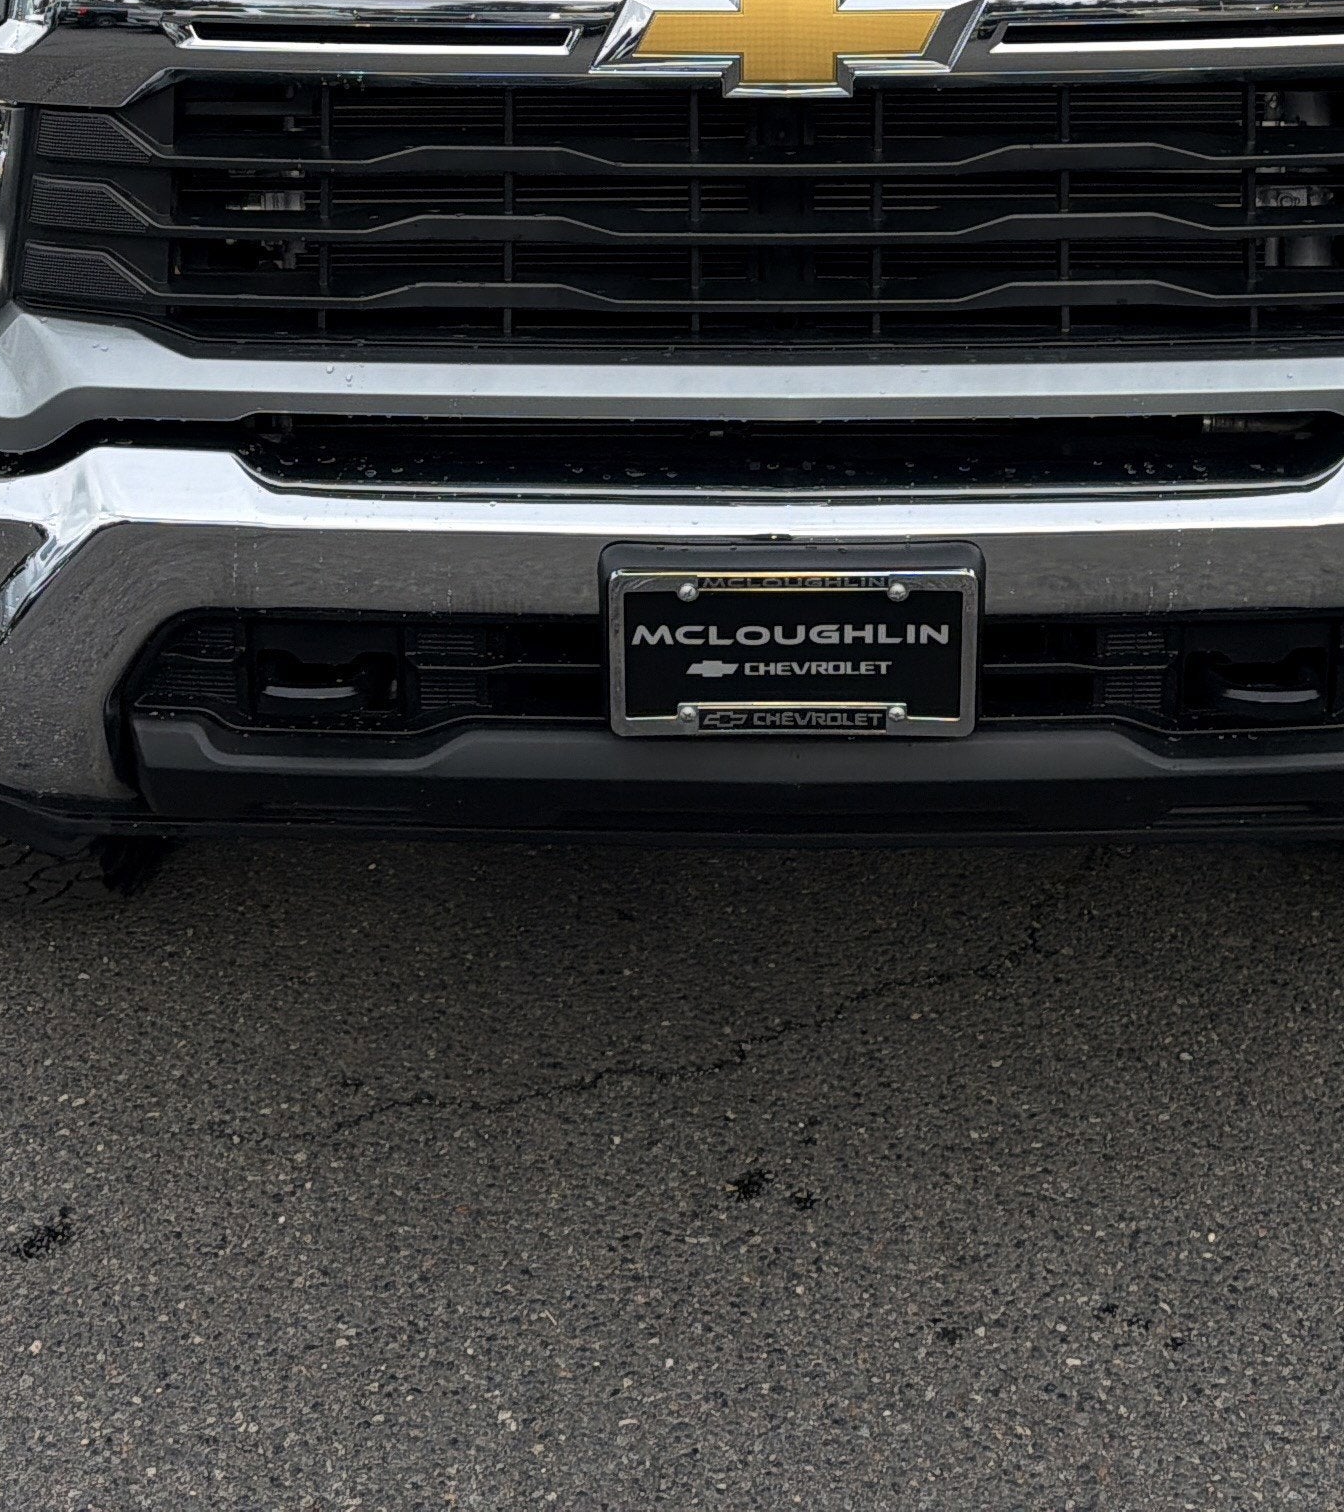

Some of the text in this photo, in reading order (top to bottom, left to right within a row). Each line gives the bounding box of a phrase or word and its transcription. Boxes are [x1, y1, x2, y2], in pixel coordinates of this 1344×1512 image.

[702, 576, 886, 588] MCLOUGHLIN
[631, 624, 949, 646] MCLOUGHLIN
[744, 661, 892, 676] CHEVROLET
[753, 712, 883, 727] CHEVROLET
